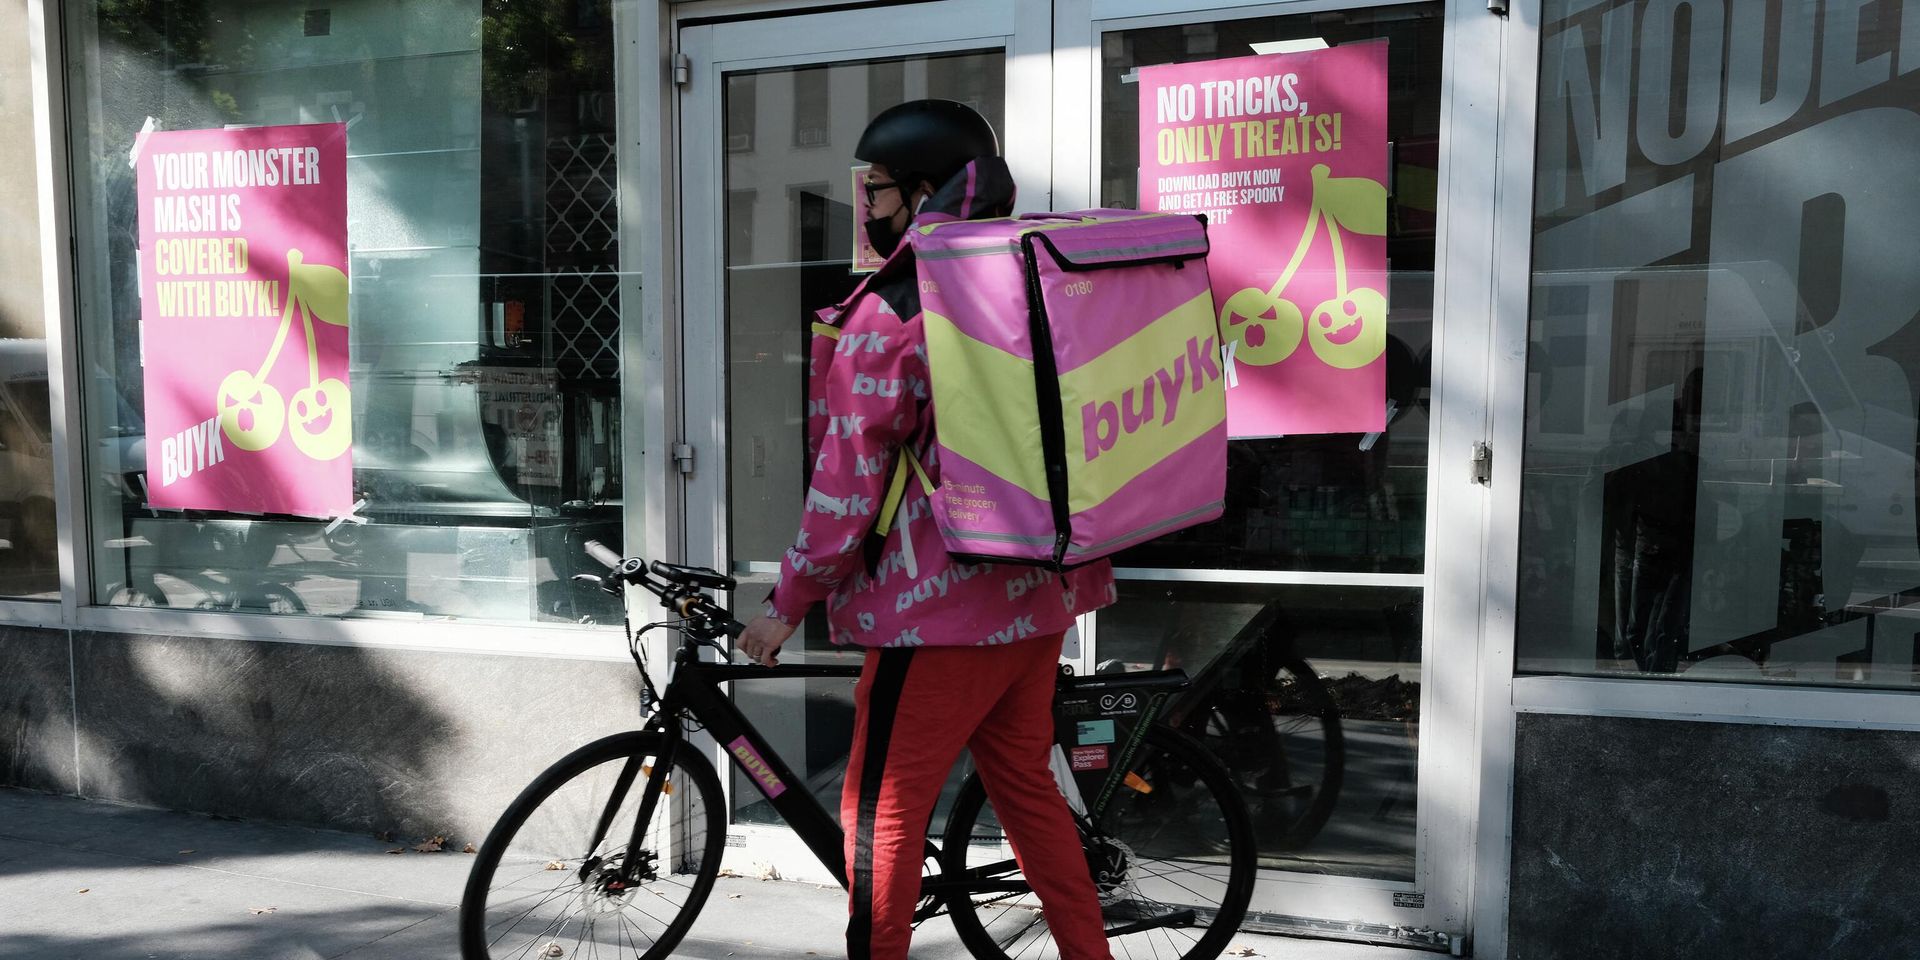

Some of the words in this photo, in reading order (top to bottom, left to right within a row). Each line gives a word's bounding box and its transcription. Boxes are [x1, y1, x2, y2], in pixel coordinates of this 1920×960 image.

[1157, 83, 1195, 124] NO
[1200, 72, 1308, 119] TRICKS,
[1157, 123, 1224, 166] ONLY
[1230, 112, 1342, 159] TREATS!
[152, 151, 209, 191] YOUR
[212, 146, 320, 189] MONSTER
[1158, 173, 1220, 194] DOWNLOAD
[1221, 170, 1252, 189] BUYK
[1253, 168, 1281, 186] NOW
[154, 194, 216, 233] MASH
[220, 193, 242, 232] IS
[1158, 194, 1181, 211] AND
[1183, 192, 1203, 209] GET
[1204, 191, 1212, 208] A
[1213, 190, 1239, 207] FREE
[1240, 186, 1285, 205] SPOOKY
[155, 237, 249, 276] COVERED
[156, 280, 210, 318] WITH
[215, 279, 280, 318] BUYK!
[1065, 280, 1093, 297] 0180
[1081, 335, 1220, 463] buyk
[161, 413, 225, 488] BUYK
[1104, 698, 1112, 706] U
[734, 745, 781, 790] BUYK
[1073, 753, 1105, 761] Explorer
